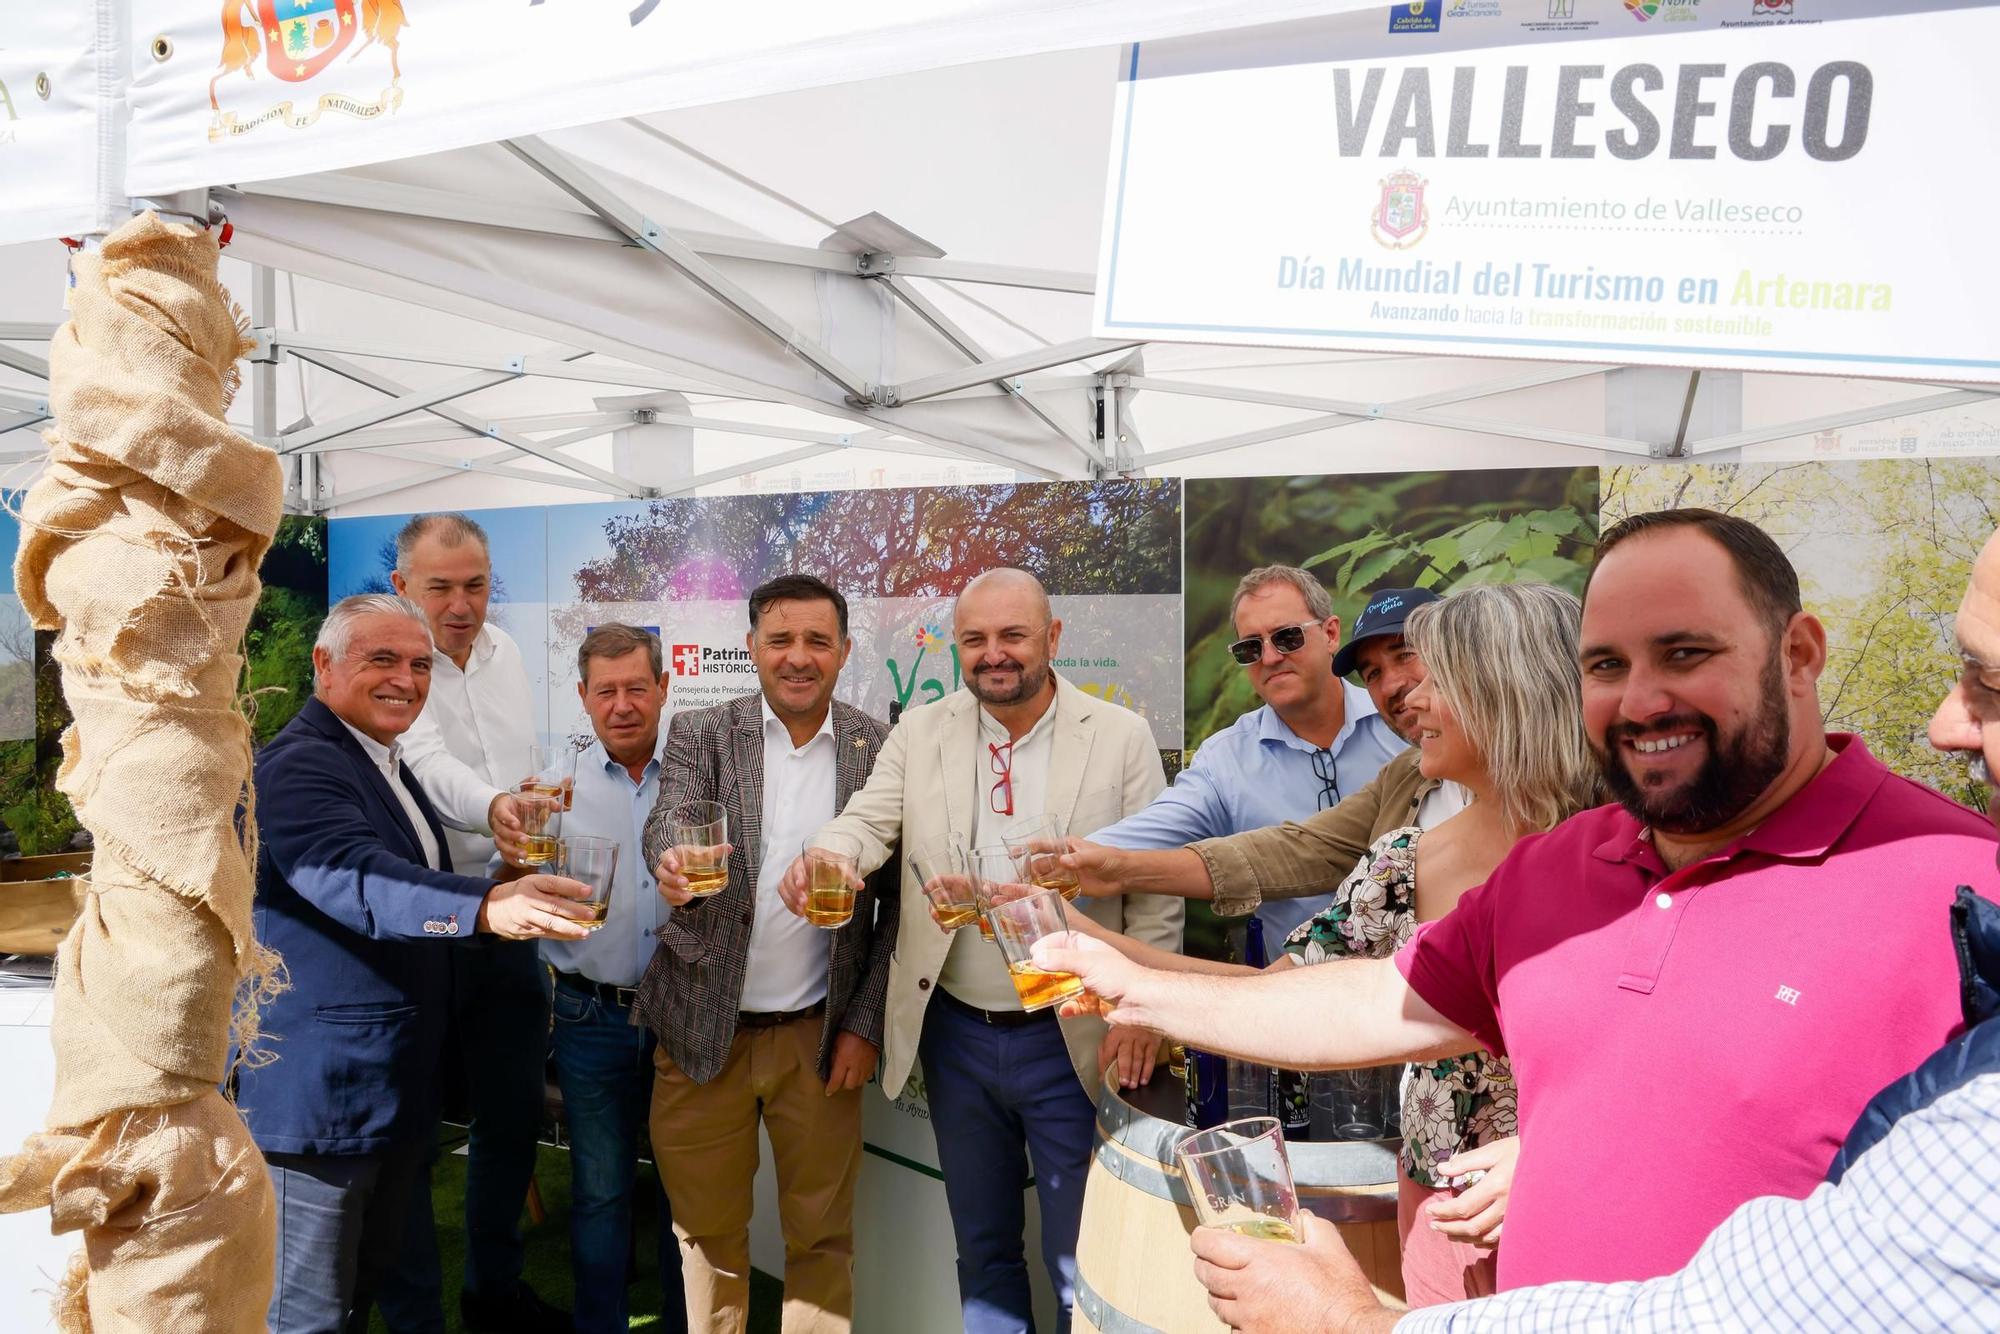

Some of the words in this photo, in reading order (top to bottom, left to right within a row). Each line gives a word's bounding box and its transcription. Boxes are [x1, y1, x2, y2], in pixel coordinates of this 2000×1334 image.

[327, 98, 381, 117] NATURALEZA
[1333, 60, 1873, 162] VALLESECO
[1445, 195, 1626, 222] Ayuntamiento
[1634, 197, 1667, 220] de
[1674, 198, 1803, 224] Valleseco
[1277, 255, 1326, 290] Día
[1336, 257, 1462, 295] Mundial
[1472, 262, 1523, 298] del
[1531, 263, 1664, 304] Turismo
[1677, 276, 1719, 305] en
[1729, 268, 1893, 313] Artenara
[1369, 300, 1460, 323] Avanzando
[1463, 303, 1505, 326] hacia
[1509, 305, 1524, 327] la
[1528, 307, 1668, 334] transformación
[1673, 312, 1773, 337] sostenible
[702, 662, 758, 673] HISTÓRICO
[1080, 656, 1090, 668] la
[1093, 656, 1120, 668] vida.
[711, 685, 720, 694] de
[678, 698, 714, 707] Movilidad
[905, 1102, 931, 1121] Ayun
[1206, 1191, 1247, 1210] GRAN
